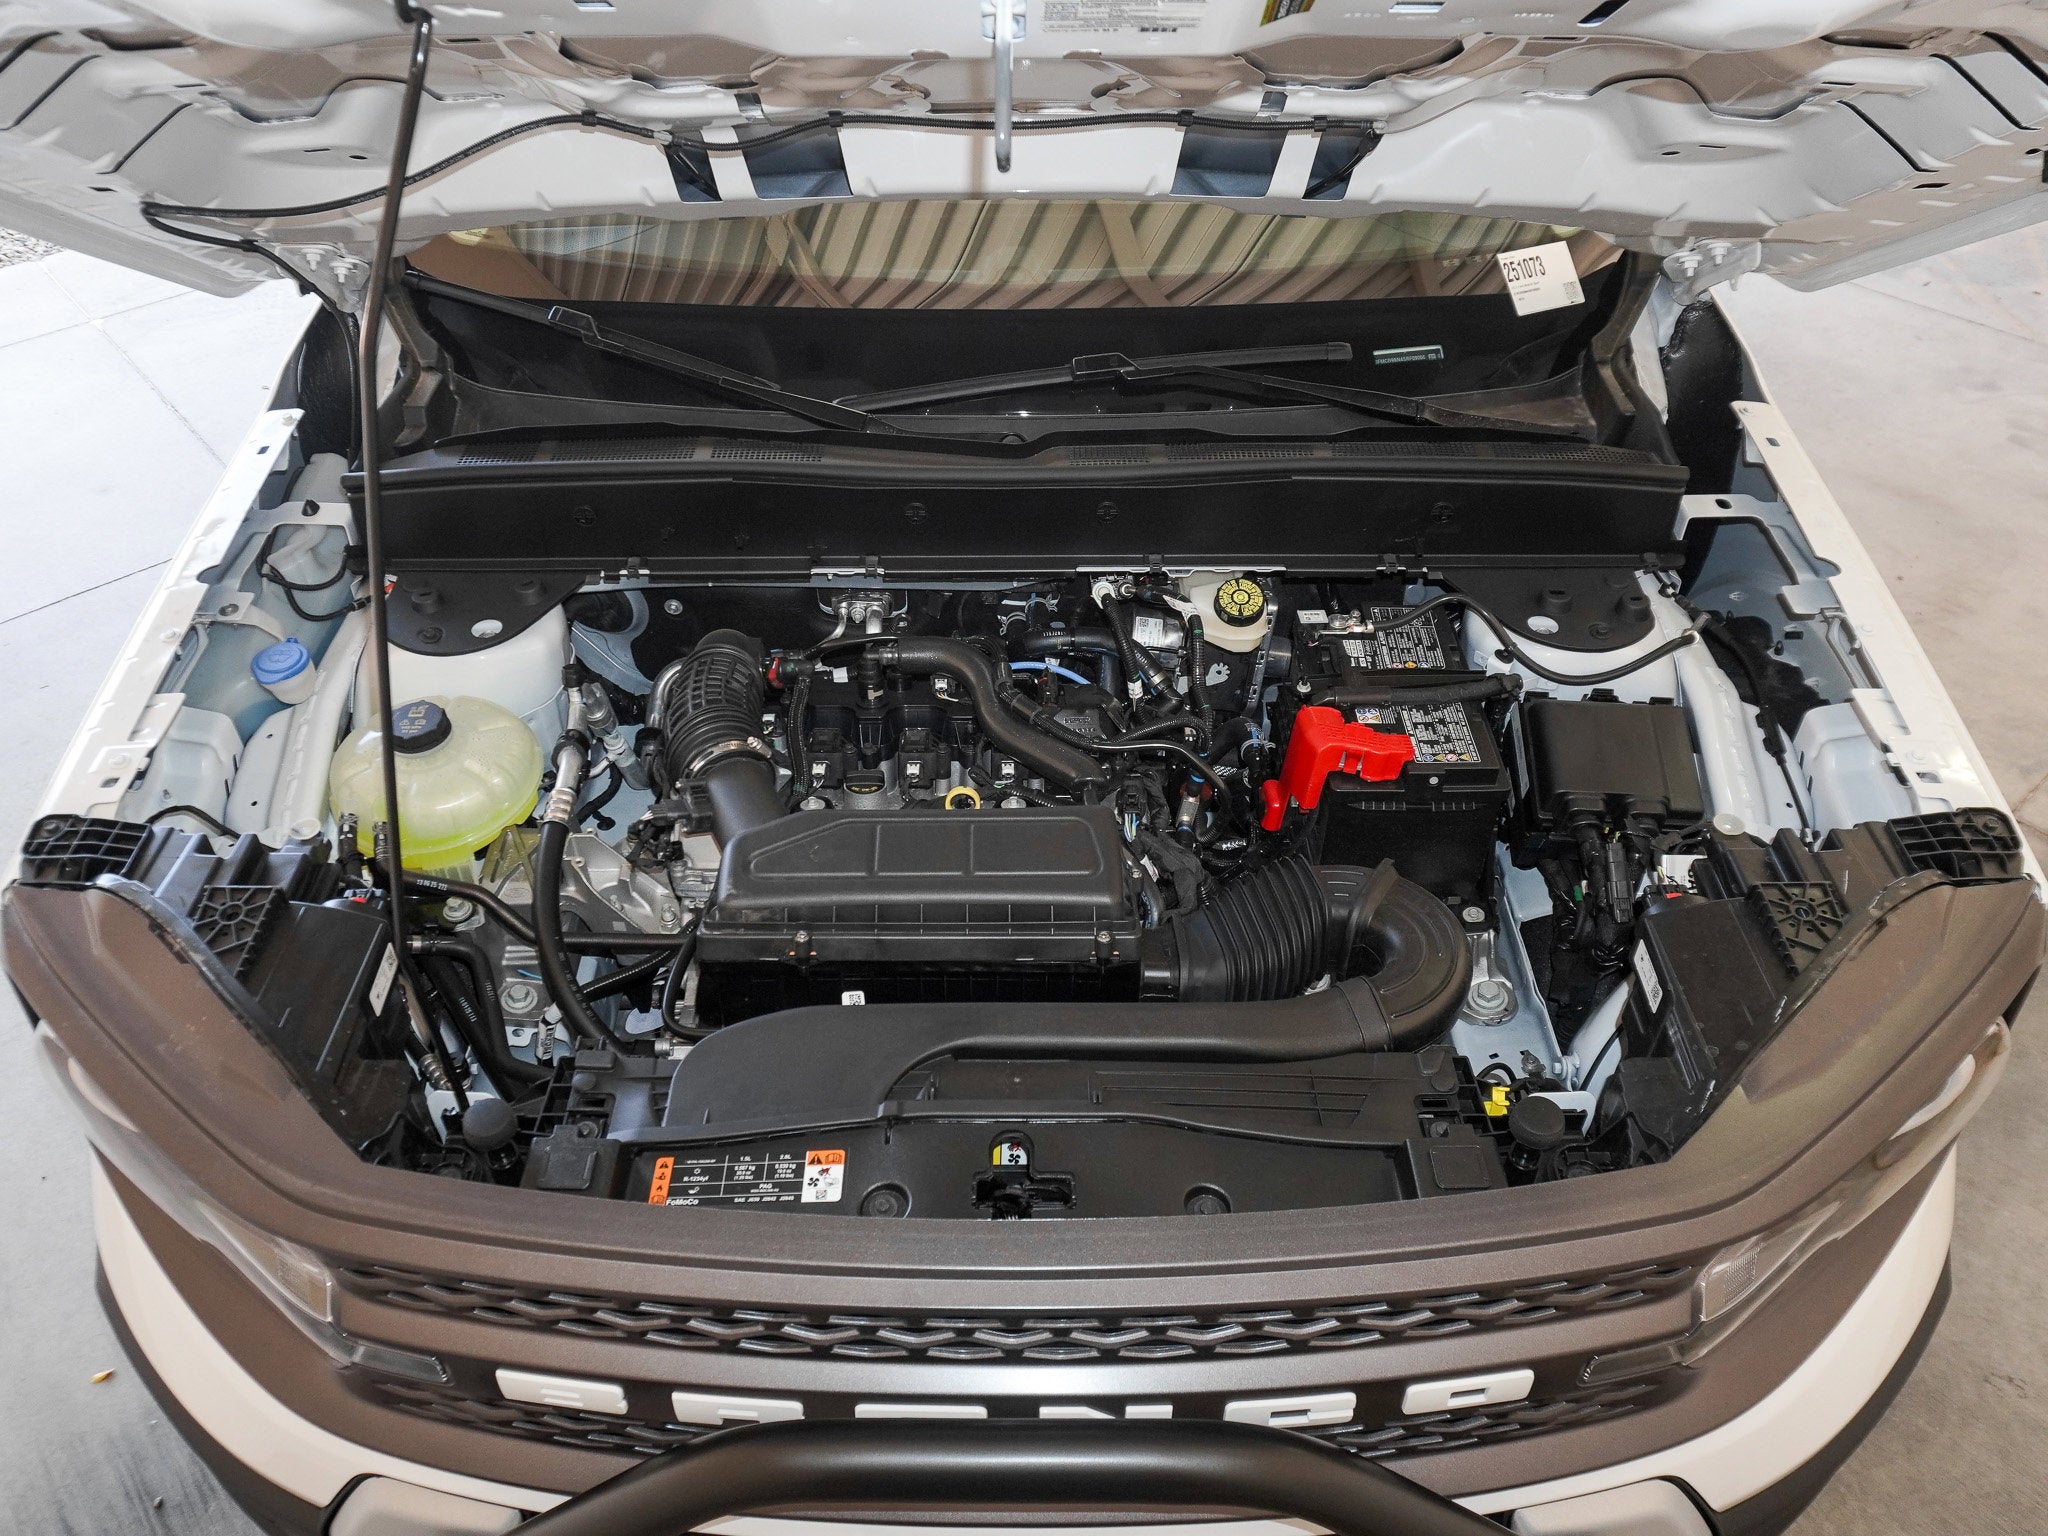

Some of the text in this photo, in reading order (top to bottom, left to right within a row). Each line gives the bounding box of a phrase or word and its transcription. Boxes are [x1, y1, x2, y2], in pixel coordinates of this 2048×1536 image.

[1503, 255, 1546, 283] 251073
[665, 1198, 699, 1206] FoMoCo
[494, 1367, 1536, 1426] BRCO
